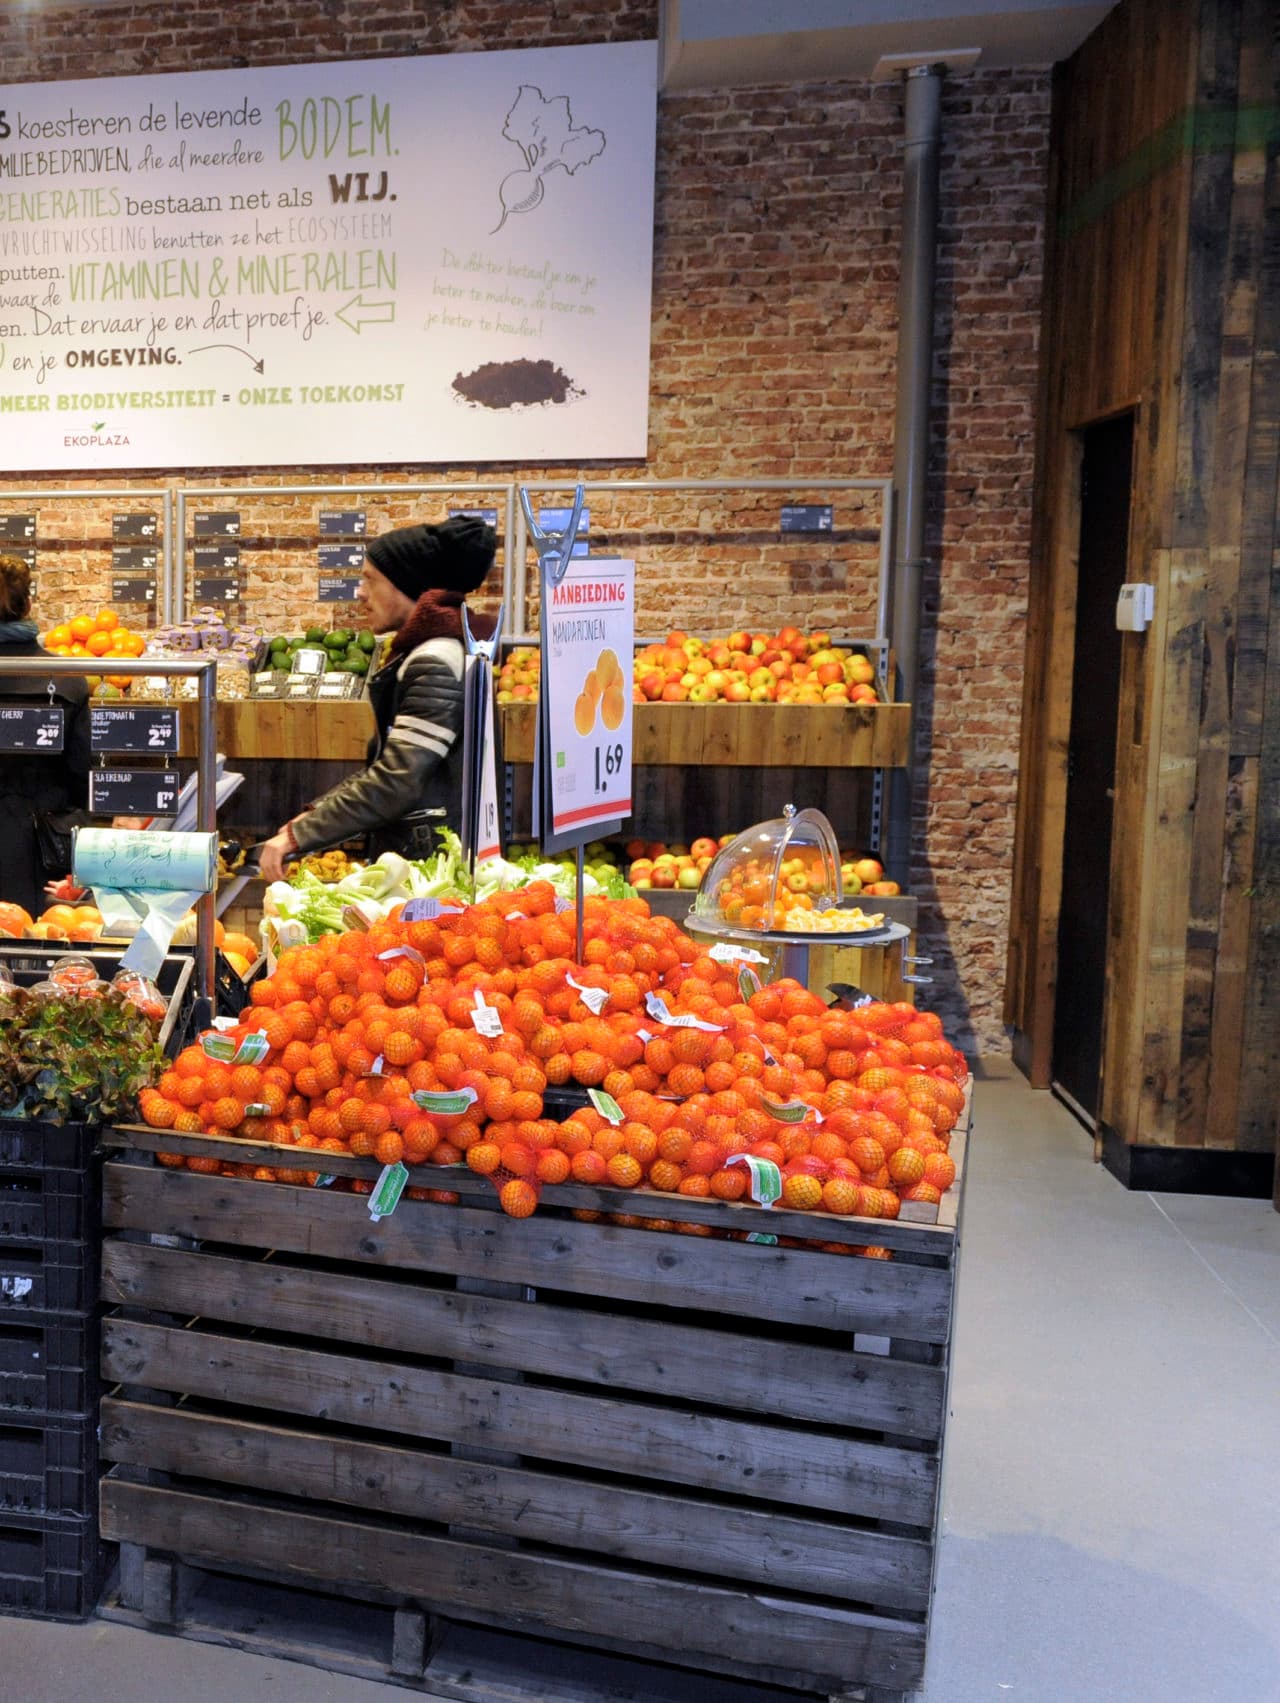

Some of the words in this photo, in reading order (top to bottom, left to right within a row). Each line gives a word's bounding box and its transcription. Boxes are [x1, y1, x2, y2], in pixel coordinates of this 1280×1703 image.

[19, 106, 131, 139] koesteren
[140, 103, 168, 131] de
[174, 97, 262, 130] levende
[276, 95, 401, 161] BODEM.
[138, 145, 166, 171] die
[169, 140, 187, 171] al
[189, 137, 263, 168] meerdere
[126, 191, 222, 215] bestaan
[230, 191, 270, 212] net
[277, 187, 313, 209] als
[329, 171, 397, 205] WIJ.
[3, 224, 147, 256] VRUCHTWISSELING
[153, 226, 224, 249] benutten
[232, 233, 251, 246] ze
[255, 218, 282, 244] het
[289, 213, 393, 242] ECOSYSTEEM
[0, 265, 65, 287] putten.
[69, 258, 200, 302] VITAMINEN
[208, 256, 228, 297] &
[237, 250, 397, 295] MINERALEN
[440, 248, 460, 268] De
[565, 273, 580, 283] om
[580, 273, 597, 295] je
[0, 291, 38, 308] waar
[42, 282, 61, 306] de
[470, 285, 482, 300] te
[578, 303, 595, 314] om
[32, 307, 75, 337] Dat
[80, 315, 146, 335] ervaar
[147, 315, 169, 345] je
[175, 316, 197, 330] en
[202, 300, 240, 330] dat
[246, 296, 303, 343] proef
[303, 309, 329, 341] je.
[424, 310, 439, 330] je
[442, 306, 473, 328] beter
[480, 314, 492, 331] te
[496, 312, 543, 338] houden!
[13, 353, 33, 371] en
[36, 351, 58, 384] je
[66, 347, 182, 369] OMGEVING.
[0, 394, 50, 413] MEER
[57, 389, 216, 411] BIODIVERSITEIT
[239, 386, 292, 405] ONZE
[299, 384, 406, 403] TOEKOMST
[63, 434, 131, 447] EKOPLAZA
[552, 583, 625, 605] AANBIEDING
[551, 619, 606, 644] MANDARIJNEN
[1, 710, 24, 720] CHERRY
[148, 728, 172, 746] 2.49
[95, 773, 105, 782] SLA
[594, 744, 623, 794] 1.69
[157, 791, 174, 809] 1.79
